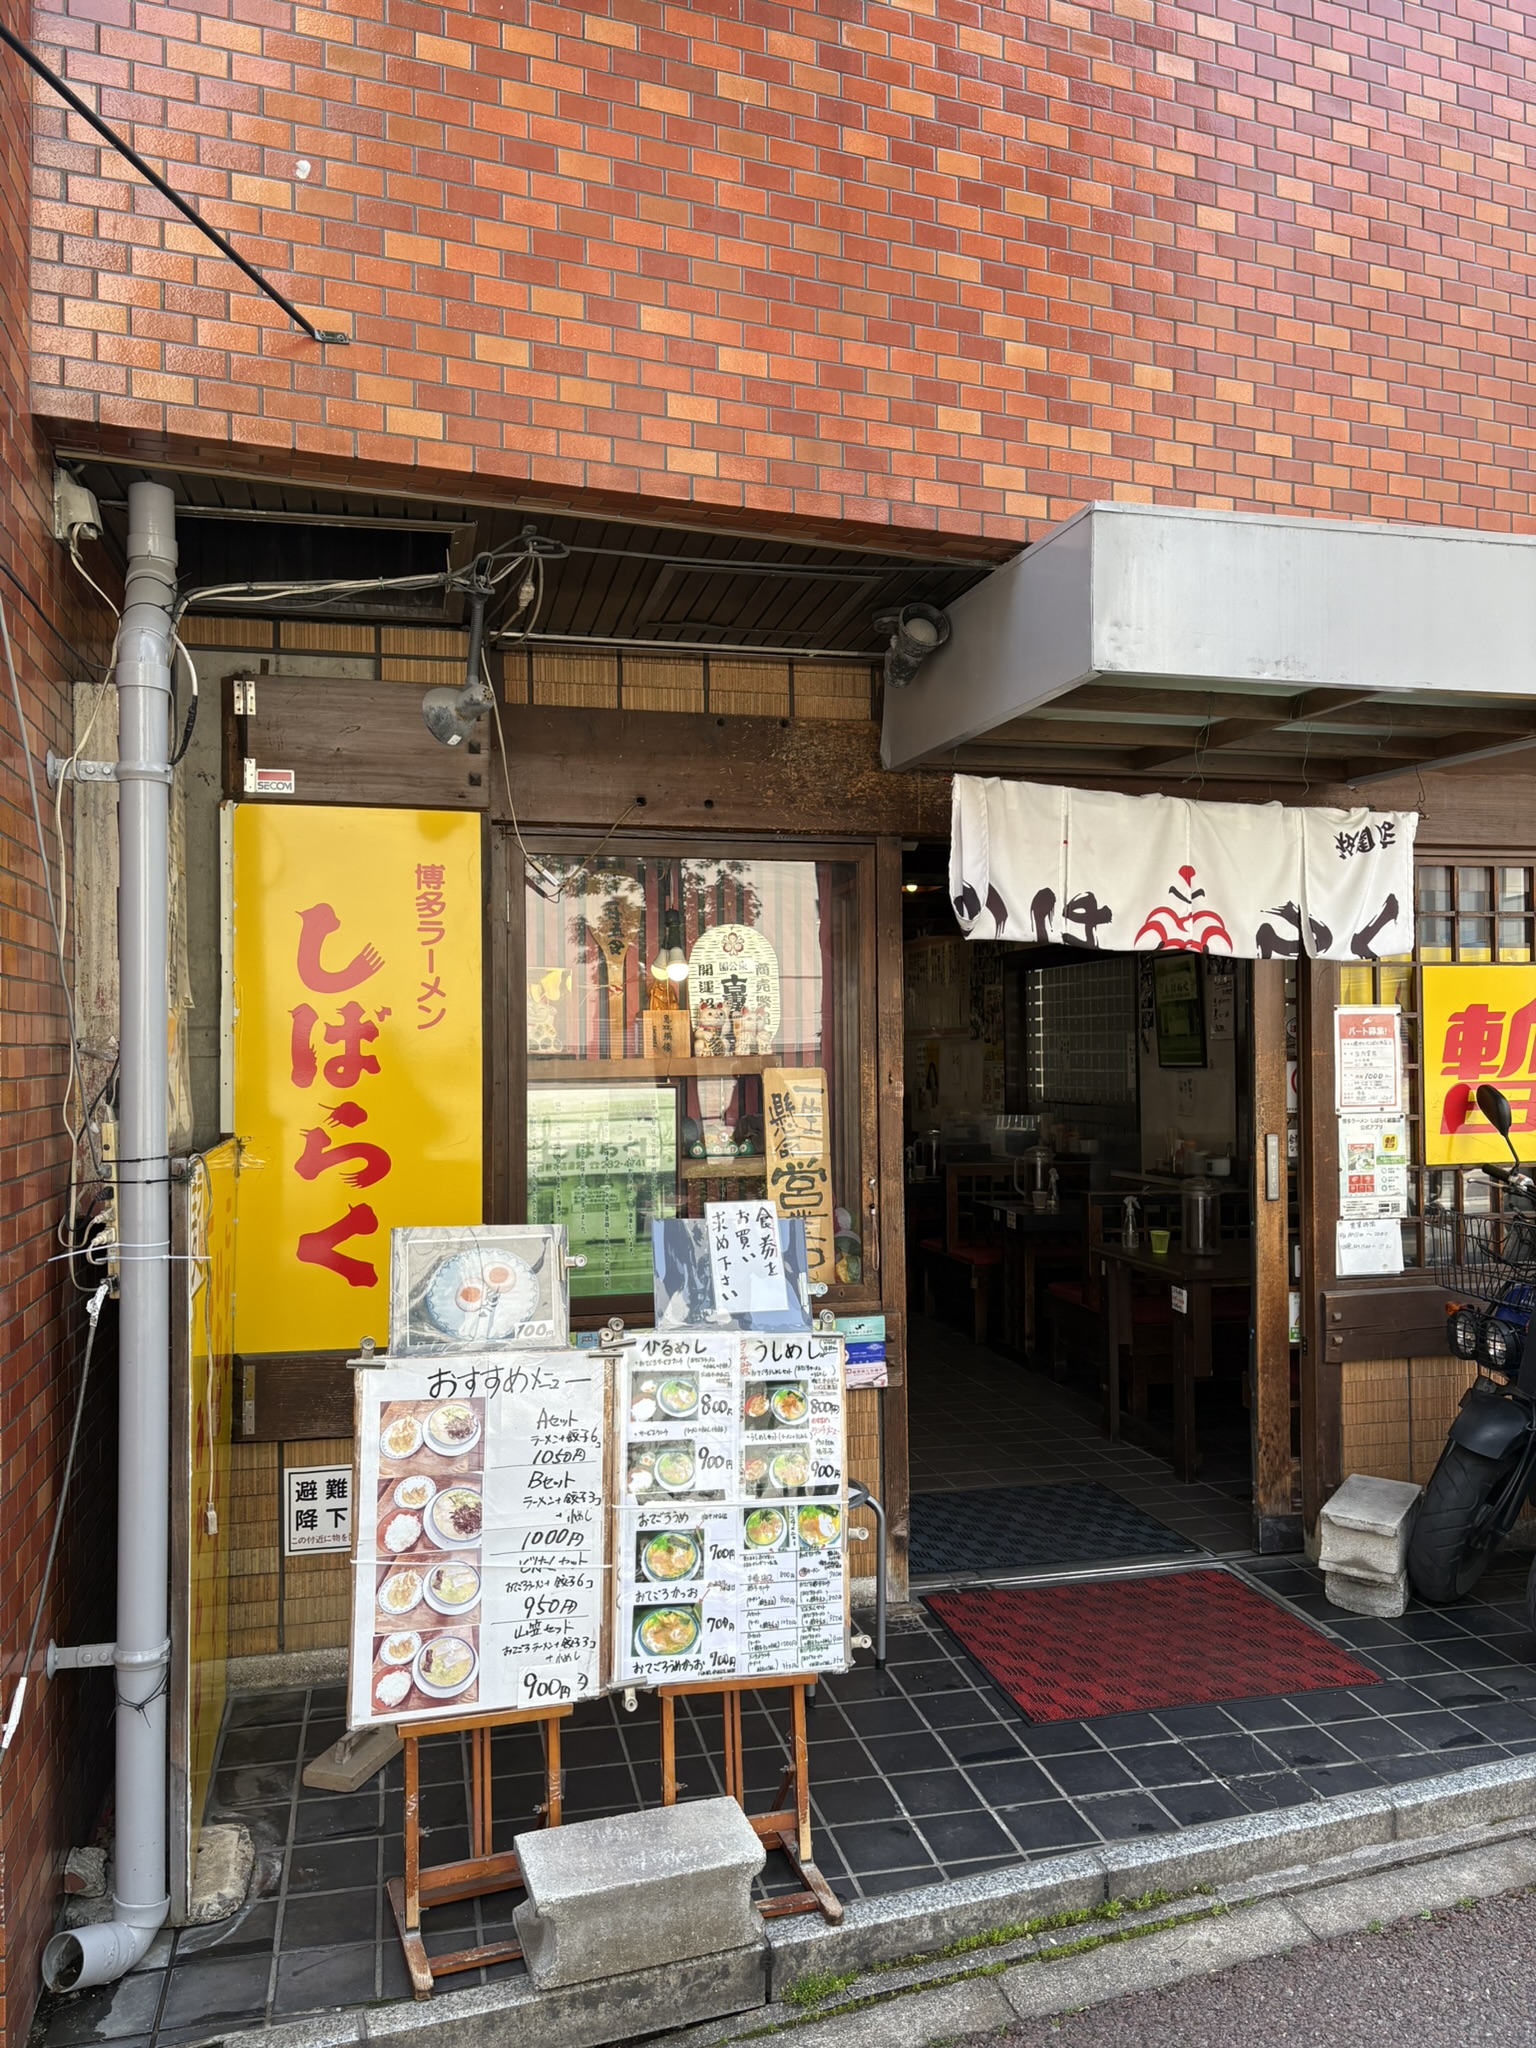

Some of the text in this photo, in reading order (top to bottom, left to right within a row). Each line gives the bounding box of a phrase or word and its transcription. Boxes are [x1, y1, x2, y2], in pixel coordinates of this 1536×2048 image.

[257, 781, 292, 791] SECOM
[414, 863, 447, 1031] 博多ラーメン
[287, 901, 393, 1289] しばらく
[735, 1209, 757, 1263] お買い
[756, 1206, 778, 1277] 食券を
[712, 1211, 739, 1302] 求め下さい
[515, 1323, 555, 1339] 100円
[642, 1338, 707, 1357] ひるめし
[754, 1339, 821, 1363] うしめし
[427, 1365, 592, 1400] おすすめメニュー
[700, 1393, 733, 1417] 800円
[810, 1398, 840, 1416] 800円
[536, 1406, 579, 1431] Aセット
[532, 1447, 587, 1465] 1050円
[697, 1446, 733, 1471] 900円
[527, 1470, 576, 1490] Bセット
[810, 1460, 841, 1479] 900円
[295, 1478, 348, 1502] 避難
[295, 1507, 348, 1531] 降下
[637, 1511, 690, 1528] おてごろうめ
[521, 1528, 585, 1550] 1000円
[709, 1544, 736, 1561] 700円
[524, 1594, 578, 1619] 950円
[706, 1617, 735, 1633] 700円
[709, 1651, 737, 1669] 700円
[523, 1672, 571, 1700] 900円
